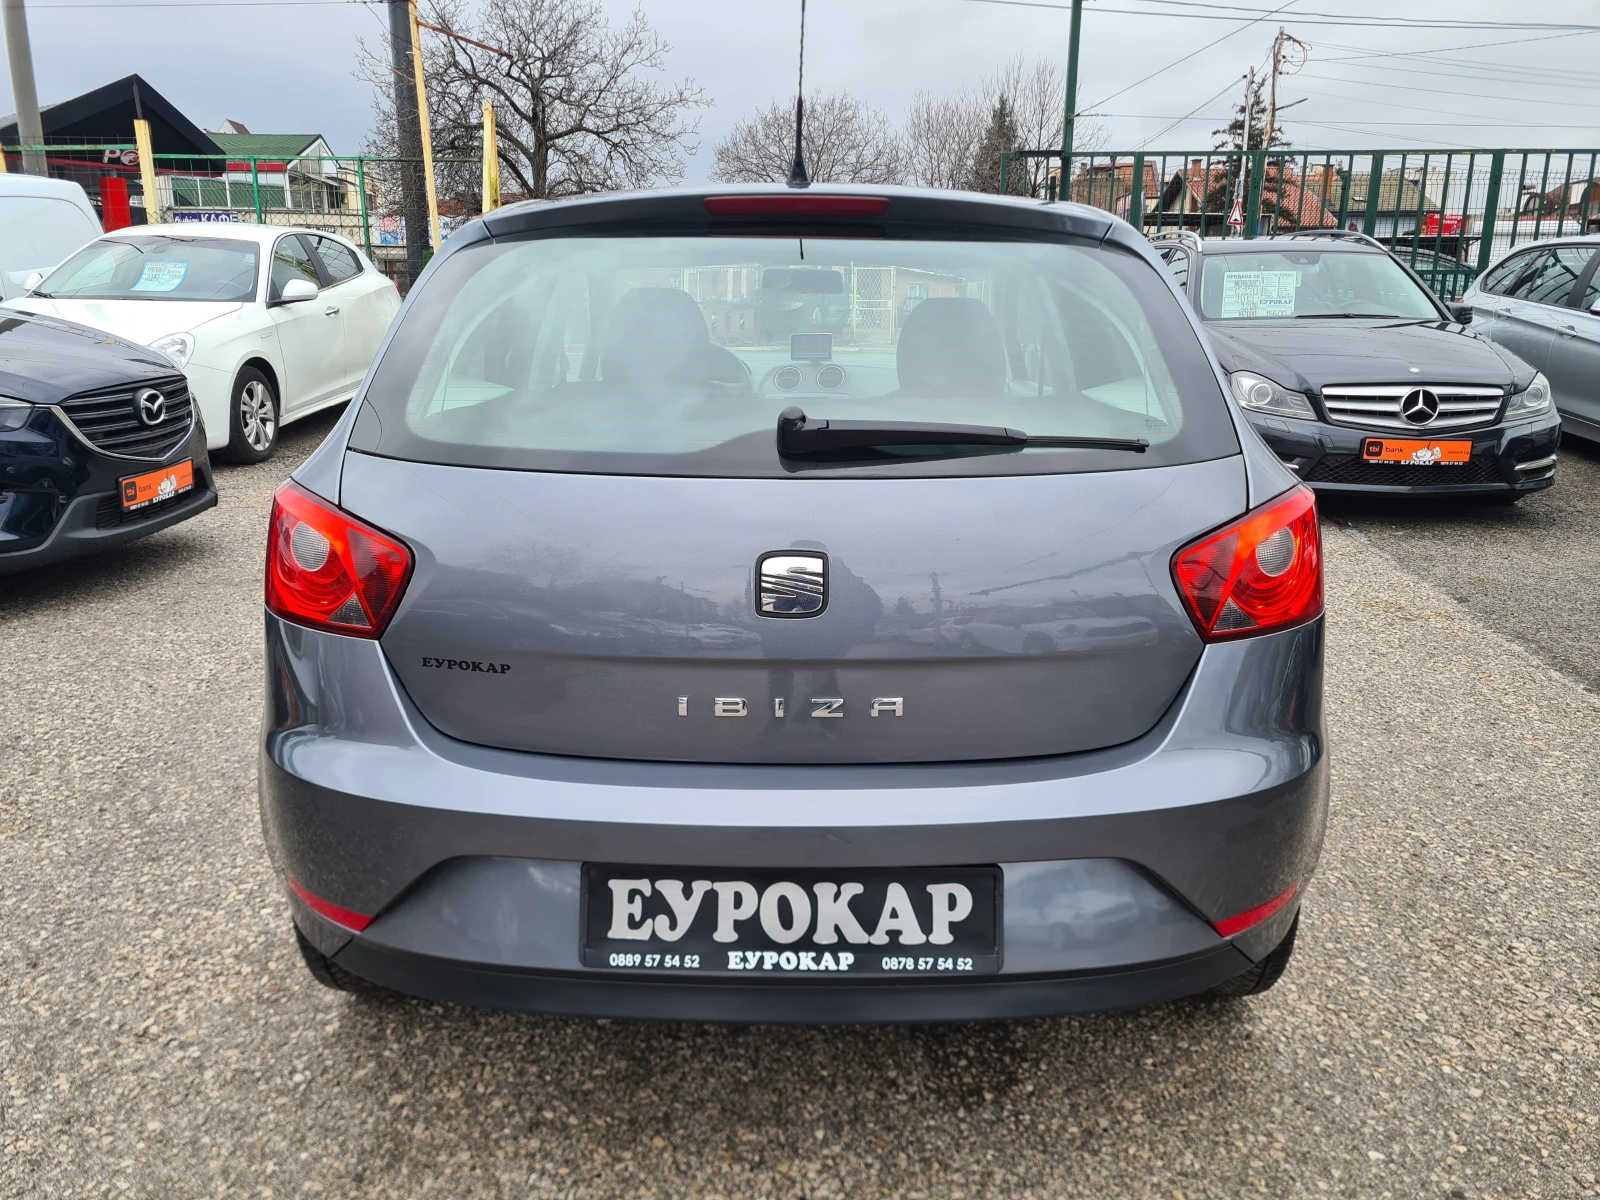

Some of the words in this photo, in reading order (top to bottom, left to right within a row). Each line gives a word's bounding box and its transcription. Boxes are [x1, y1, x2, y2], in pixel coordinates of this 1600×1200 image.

[201, 213, 239, 223] КАФЕ
[138, 483, 153, 493] bank
[421, 656, 511, 674] ЕУРОКАР
[677, 695, 904, 718] IBIZA
[607, 878, 974, 946] ЕУРОКАР
[609, 953, 642, 967] 0889
[644, 954, 661, 967] 57
[664, 954, 680, 968] 54
[683, 955, 700, 968] 52
[727, 951, 855, 971] ЕУРОКАР
[881, 957, 915, 971] 0878
[917, 957, 934, 971] 57
[937, 958, 953, 971] 54
[956, 958, 973, 971] 52
